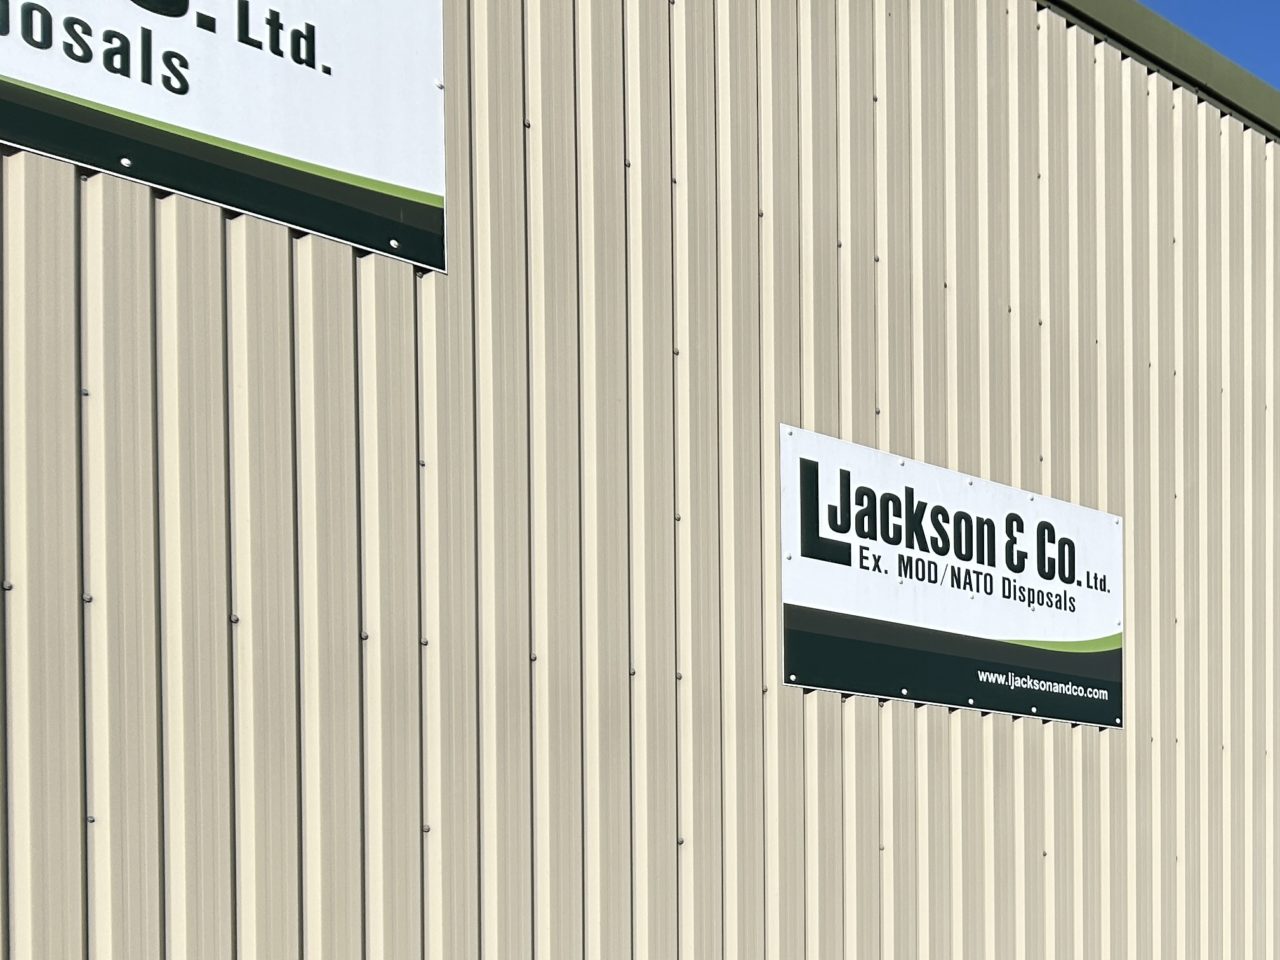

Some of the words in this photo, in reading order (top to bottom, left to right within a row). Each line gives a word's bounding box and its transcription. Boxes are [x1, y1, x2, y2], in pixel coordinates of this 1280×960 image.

[0, 0, 190, 96] osals
[237, 0, 332, 76] Ltd.
[859, 545, 889, 575] Ex.
[897, 553, 994, 596] MOD/NATO
[1001, 576, 1077, 614] Disposals
[1004, 512, 1028, 574] &
[1036, 520, 1083, 588] Co.
[1086, 571, 1111, 594] Ltd.
[977, 669, 1109, 701] www.ljacksonandco.com
